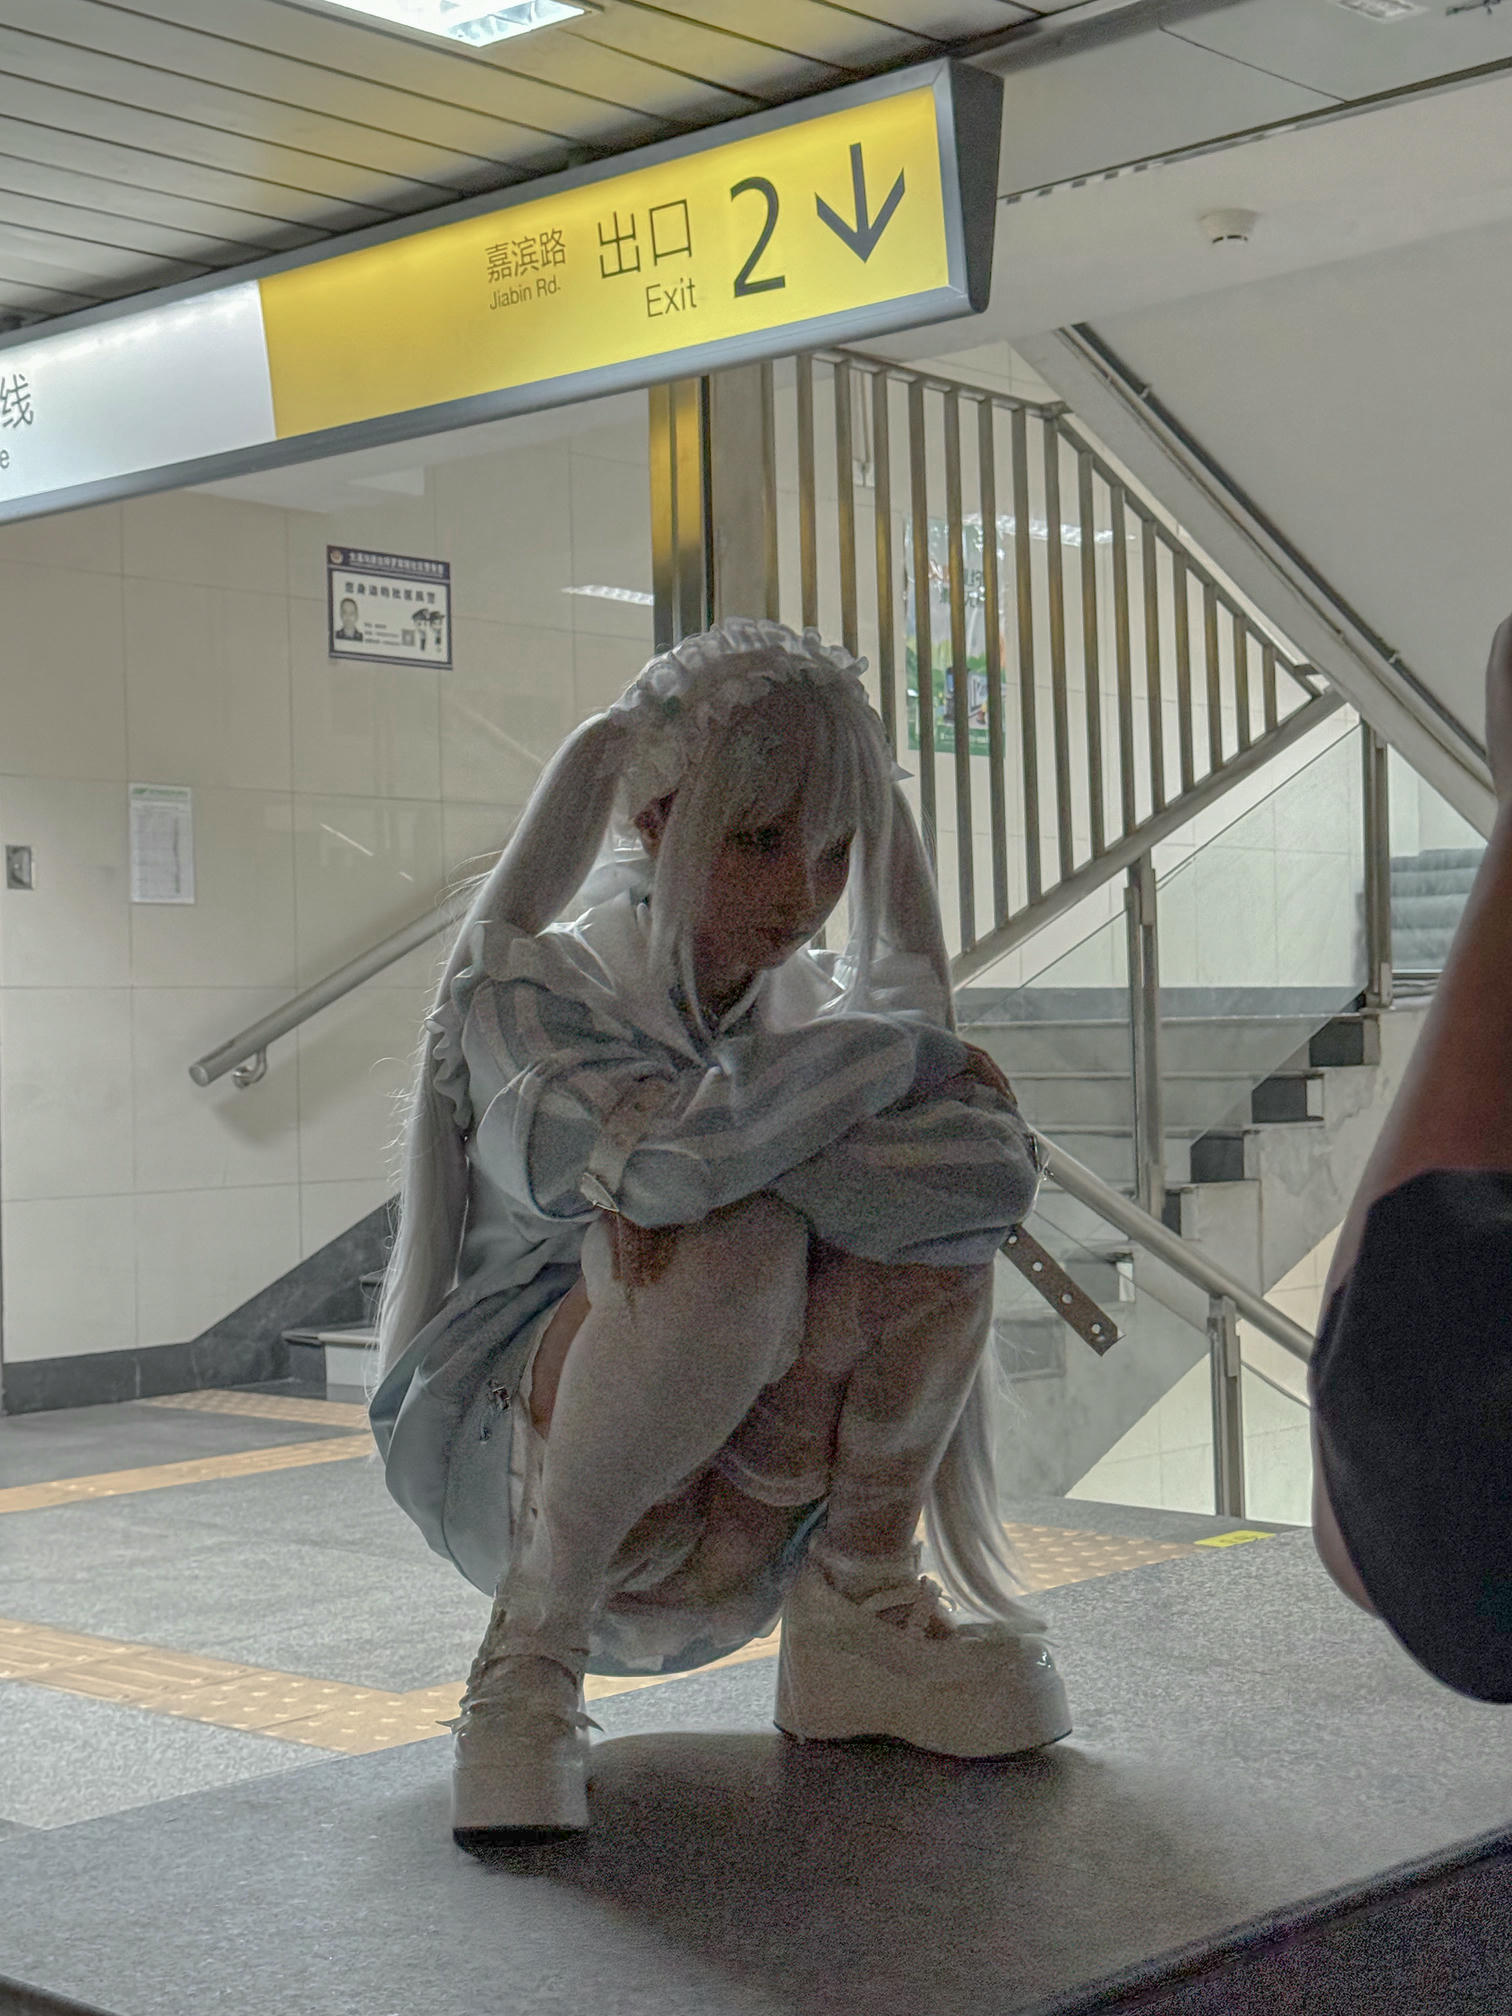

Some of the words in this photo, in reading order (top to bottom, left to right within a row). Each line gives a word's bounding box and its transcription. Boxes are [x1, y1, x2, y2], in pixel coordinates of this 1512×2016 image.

[485, 228, 566, 283] 嘉滨路
[597, 199, 692, 279] 出口
[730, 176, 786, 298] 2
[489, 285, 533, 311] Jiabin
[536, 275, 562, 294] Rd.
[646, 277, 698, 318] Exit
